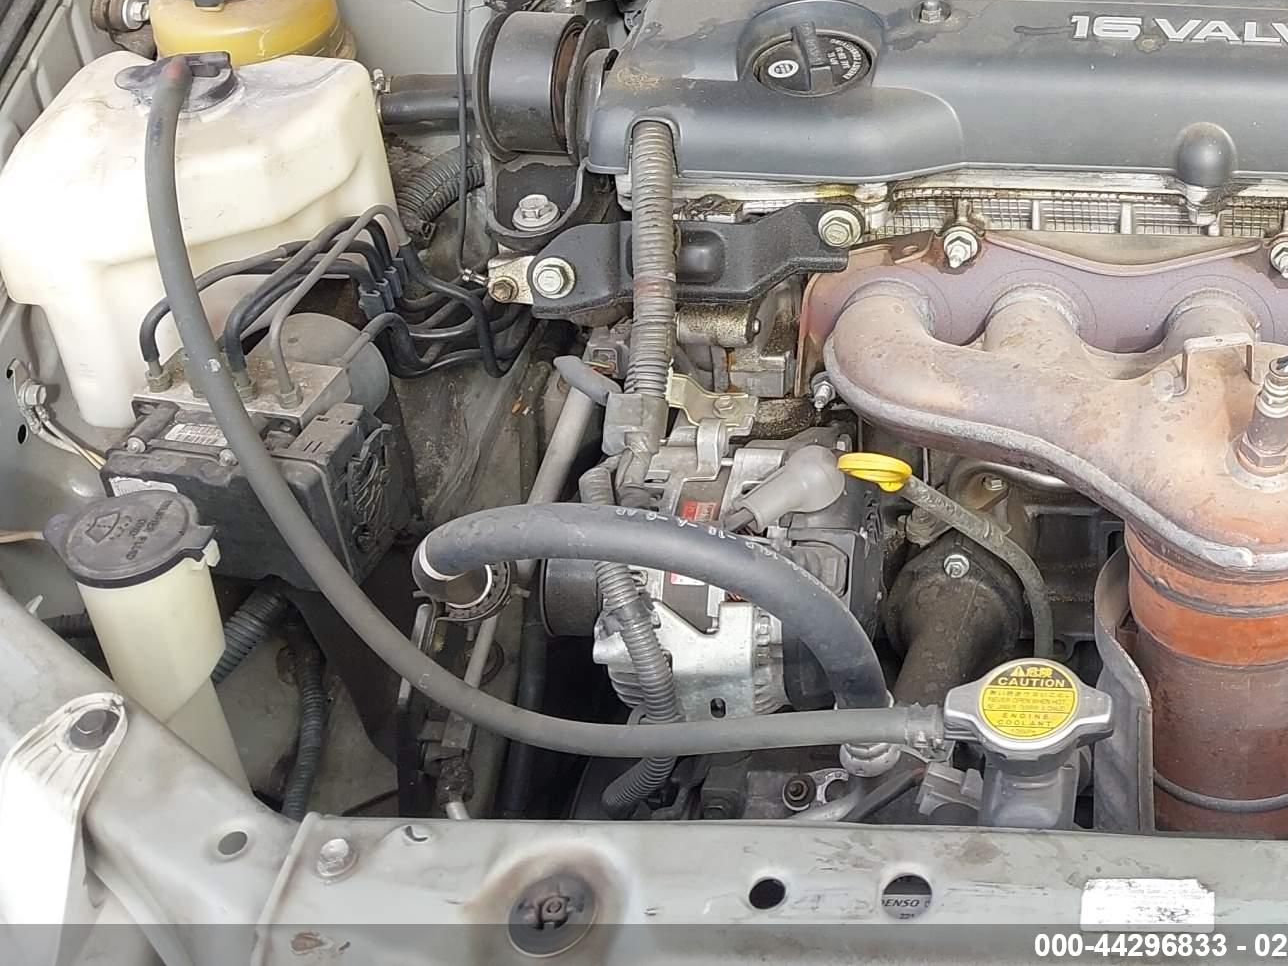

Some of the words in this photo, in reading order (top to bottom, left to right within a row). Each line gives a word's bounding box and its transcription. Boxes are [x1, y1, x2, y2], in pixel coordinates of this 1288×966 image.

[1070, 15, 1143, 41] 16
[998, 677, 1065, 688] CAUTION
[1002, 712, 1049, 720] ENGINE
[997, 719, 1053, 727] COOLANT
